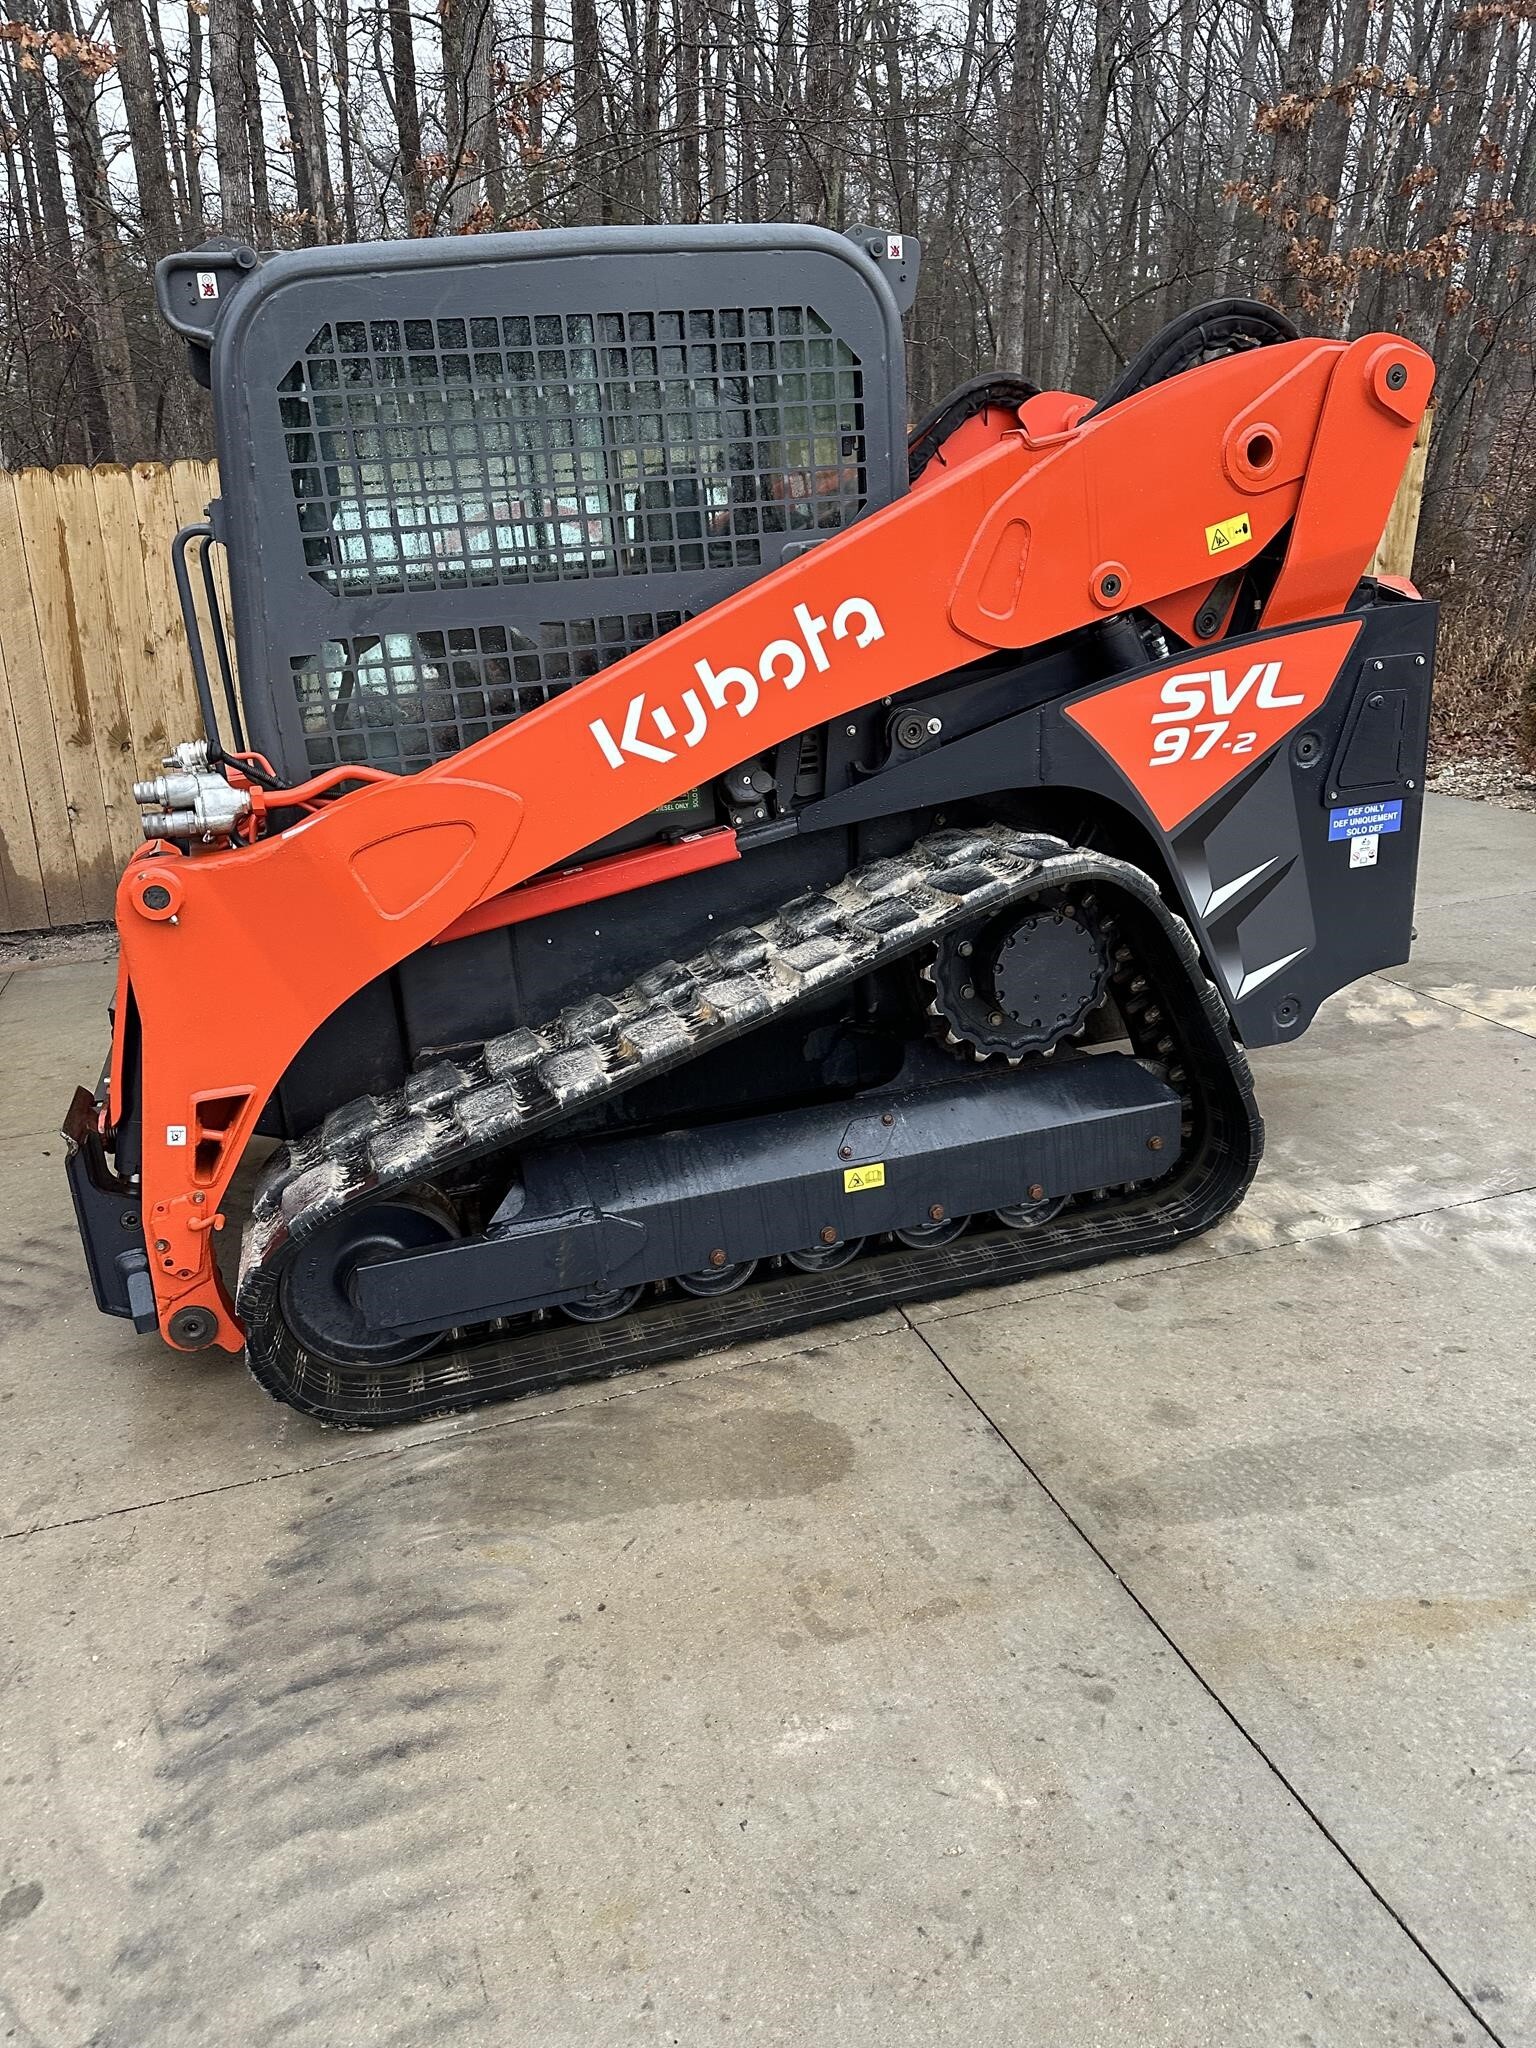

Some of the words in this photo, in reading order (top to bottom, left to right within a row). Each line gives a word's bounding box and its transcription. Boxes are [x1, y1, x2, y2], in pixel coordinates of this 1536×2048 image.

[588, 597, 886, 770] Kubota
[1150, 661, 1305, 724] SVL
[1149, 720, 1258, 767] 97-2
[1333, 819, 1348, 828] DEF
[1350, 812, 1398, 825] UNIQUEMENT
[1348, 807, 1363, 816] DEF
[1364, 804, 1384, 814] ONLY
[1346, 827, 1367, 836] SOLO
